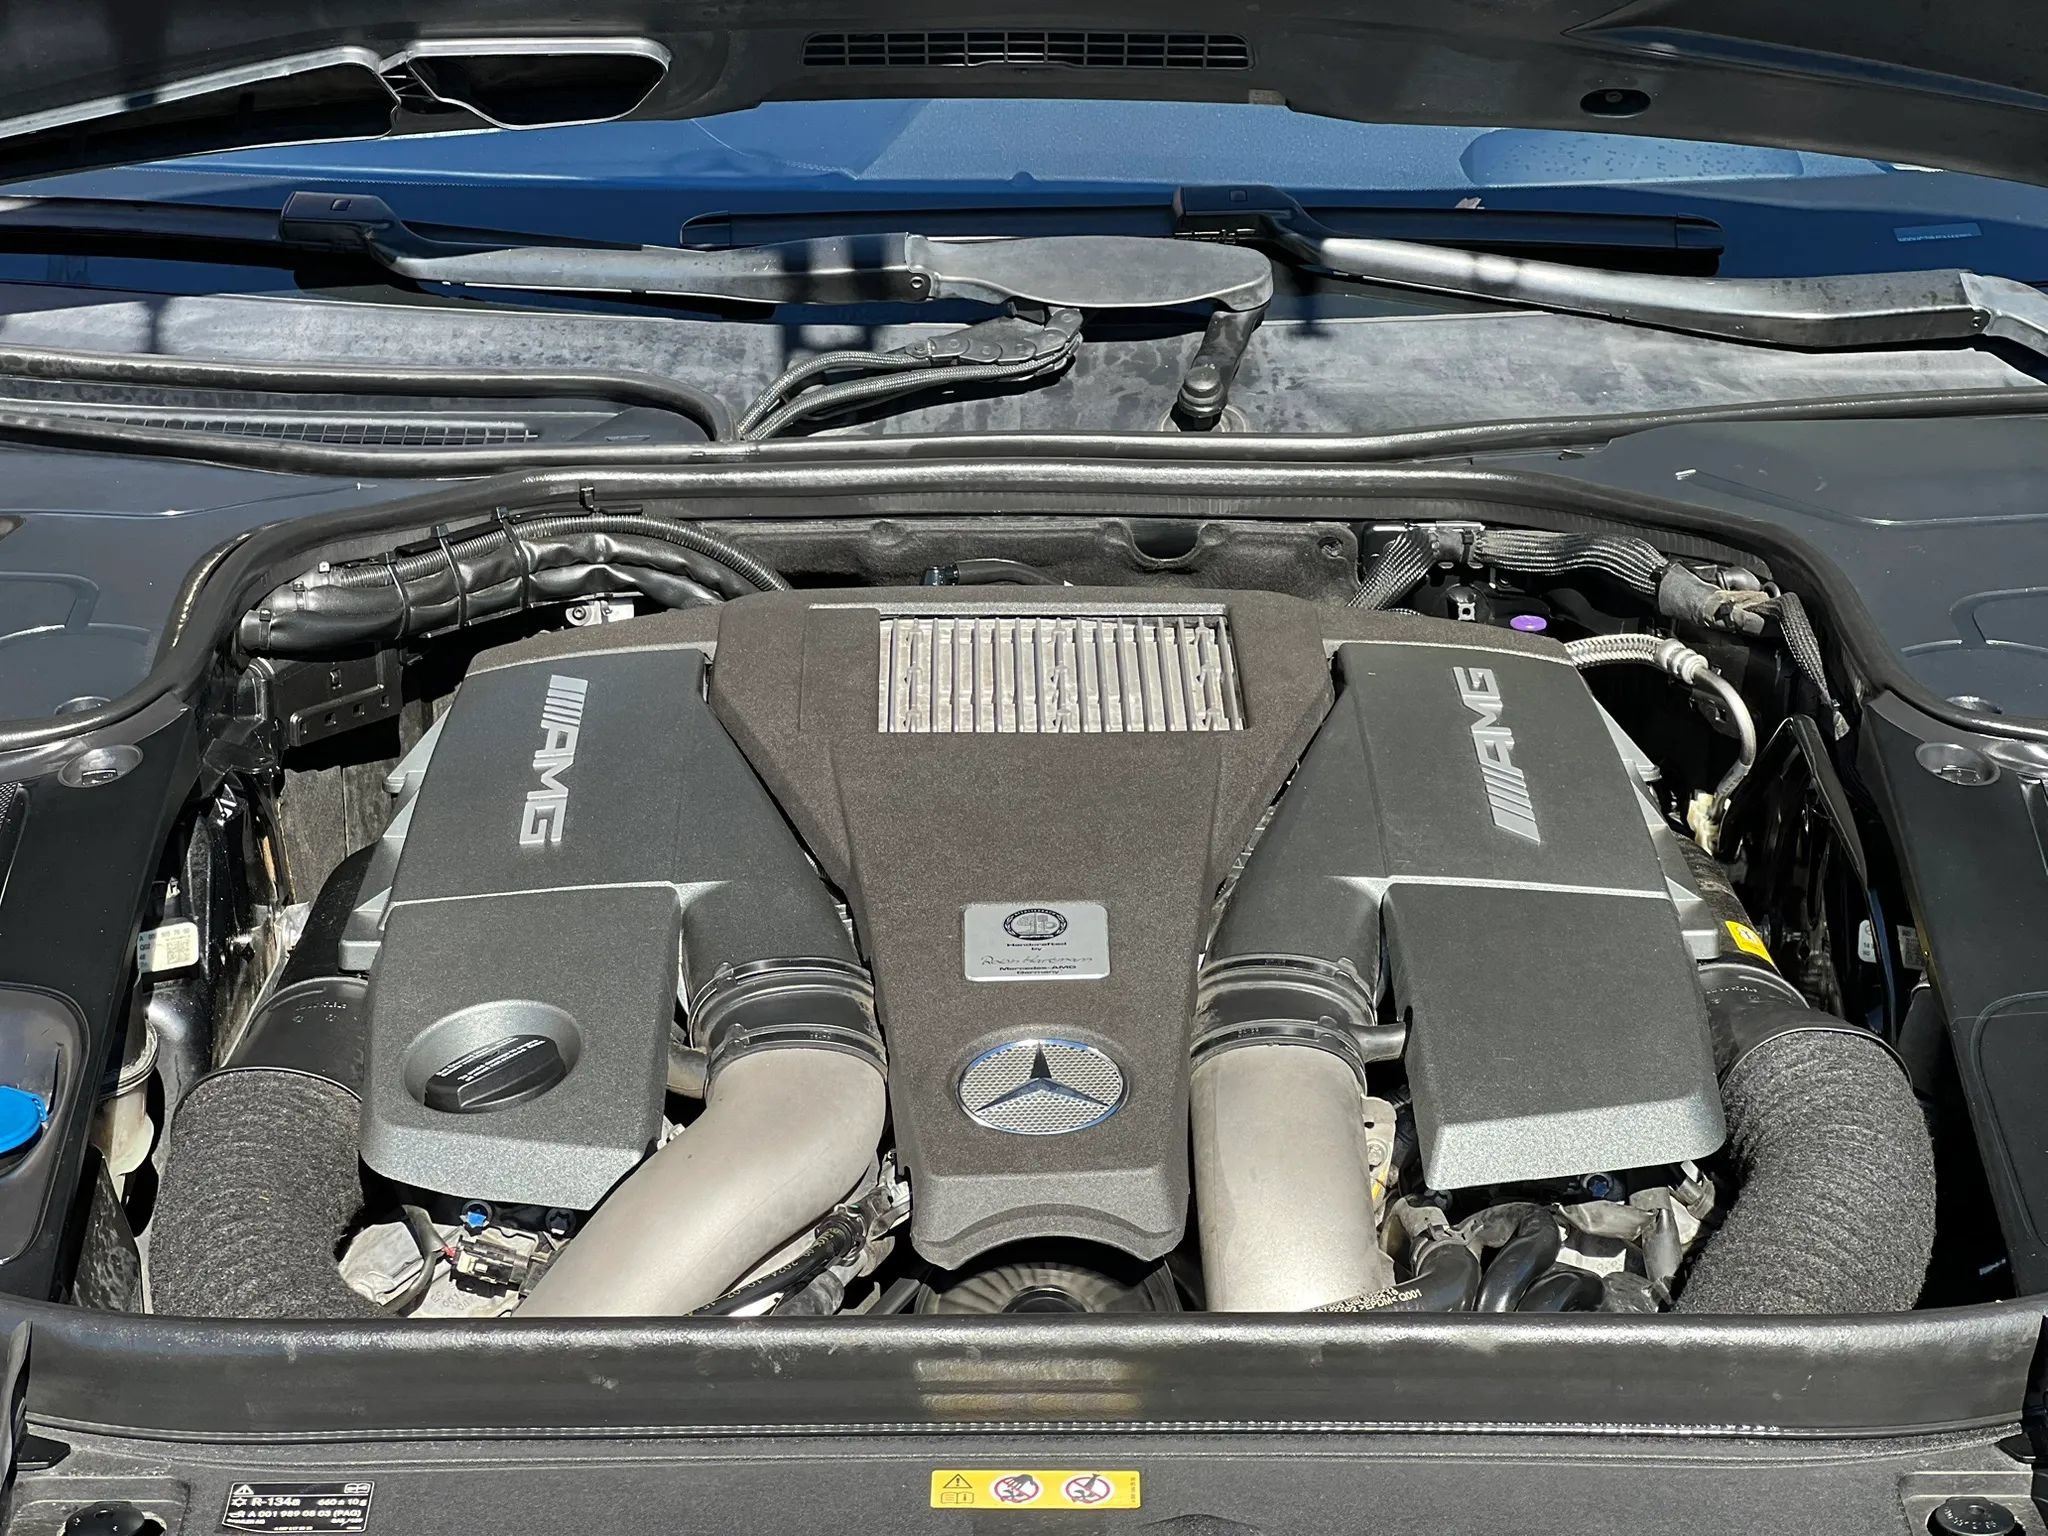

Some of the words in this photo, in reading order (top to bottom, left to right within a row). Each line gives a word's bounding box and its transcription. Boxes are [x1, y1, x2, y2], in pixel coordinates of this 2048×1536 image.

[1452, 666, 1525, 782] AMG
[519, 717, 581, 845] AMG
[251, 1498, 301, 1506] R-134a
[258, 1510, 278, 1518] 001
[333, 1509, 362, 1518] (PAG)
